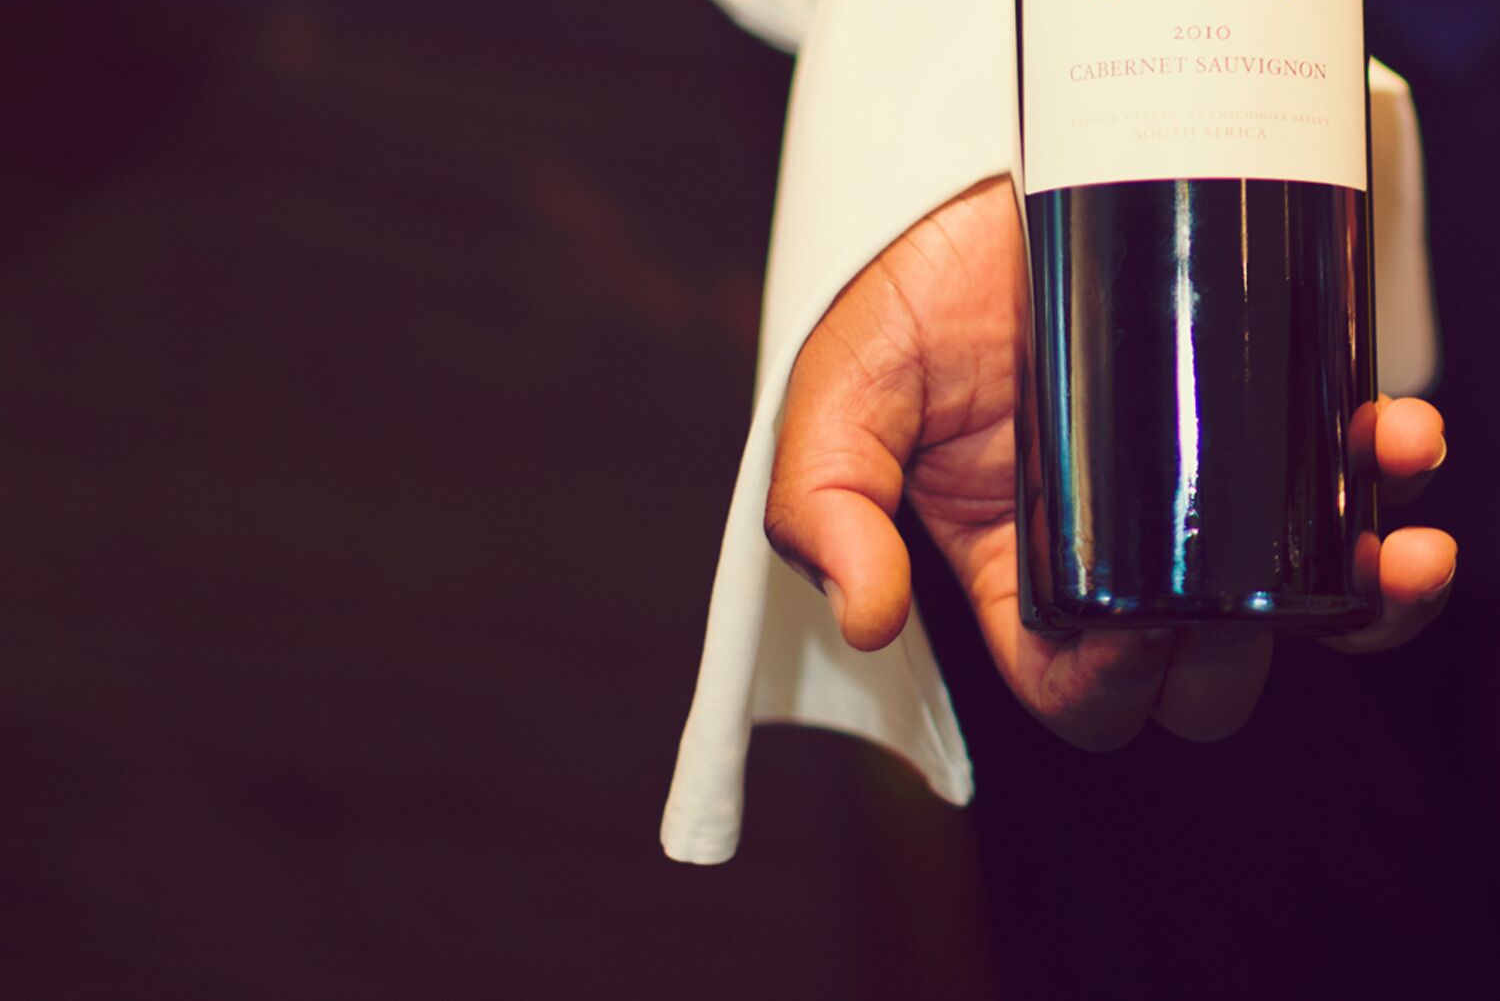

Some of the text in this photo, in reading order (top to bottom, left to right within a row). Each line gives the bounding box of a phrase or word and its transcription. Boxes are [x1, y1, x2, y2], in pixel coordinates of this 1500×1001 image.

[1173, 25, 1231, 41] 2010
[1068, 56, 1328, 82] CABERNET SAUVIGNON
[1134, 126, 1268, 141] SOUTH AFRICA
